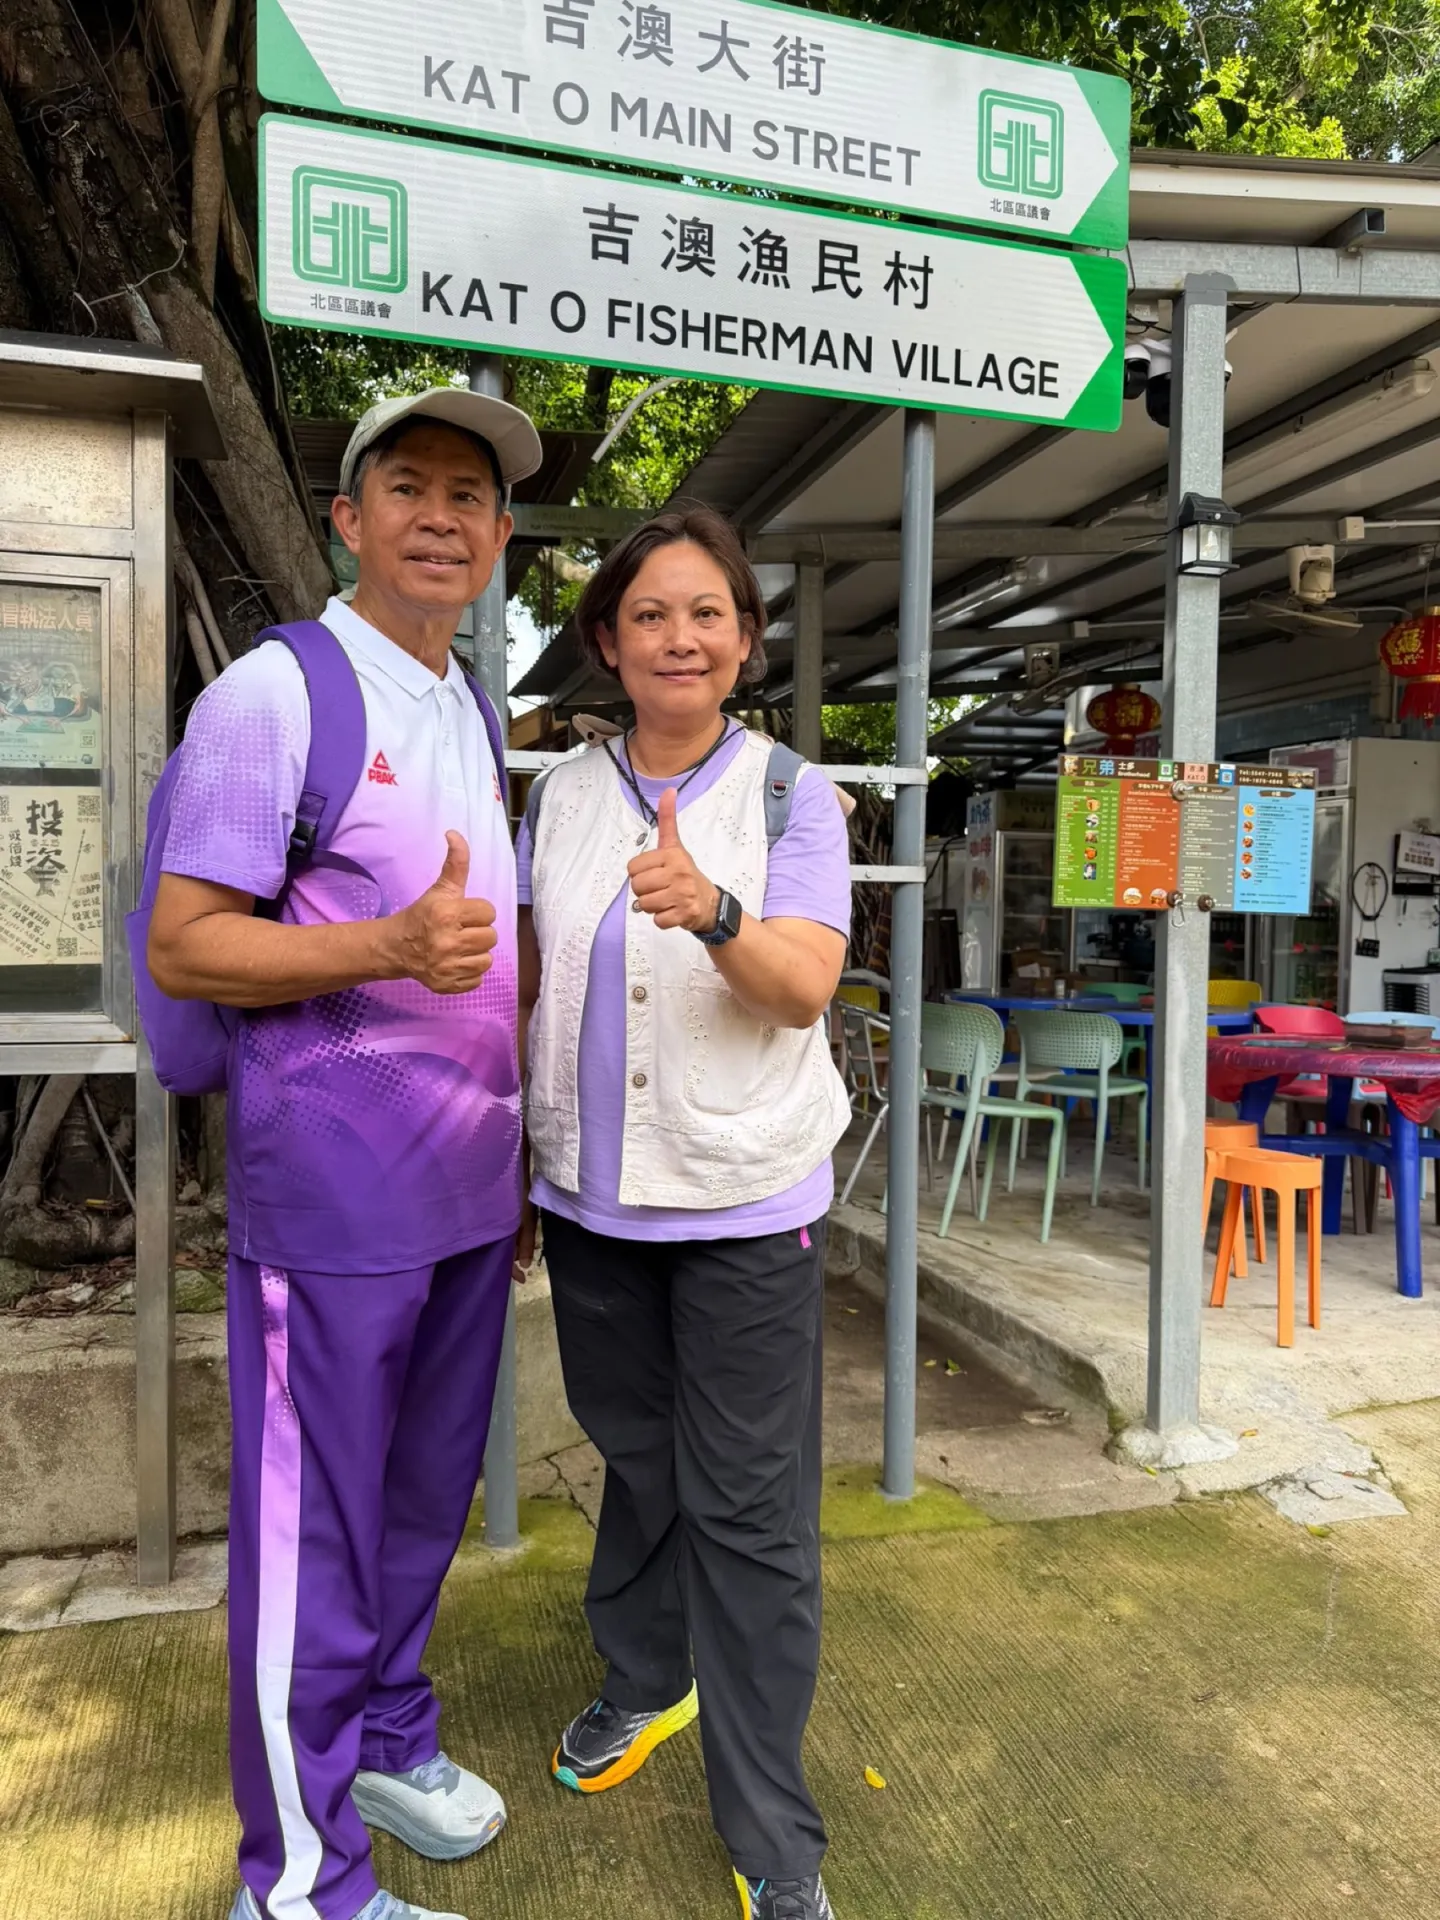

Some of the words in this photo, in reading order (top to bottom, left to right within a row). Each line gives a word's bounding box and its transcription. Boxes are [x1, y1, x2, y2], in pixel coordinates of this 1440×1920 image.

[543, 0, 827, 96] 吉澳大街
[423, 55, 531, 115] KAT
[552, 81, 590, 125] O
[610, 91, 732, 153] MAIN
[752, 119, 921, 186] STREET
[989, 197, 1051, 221] 北區區議會
[582, 202, 934, 309] 吉澳漁民村
[310, 293, 392, 319] 北區區議會
[422, 271, 529, 325] KAT
[550, 290, 587, 333] O
[607, 298, 873, 373] FISHERMAN
[891, 339, 1060, 399] VILLAGE
[368, 768, 399, 786] PEAK
[1082, 758, 1114, 776] 兄弟
